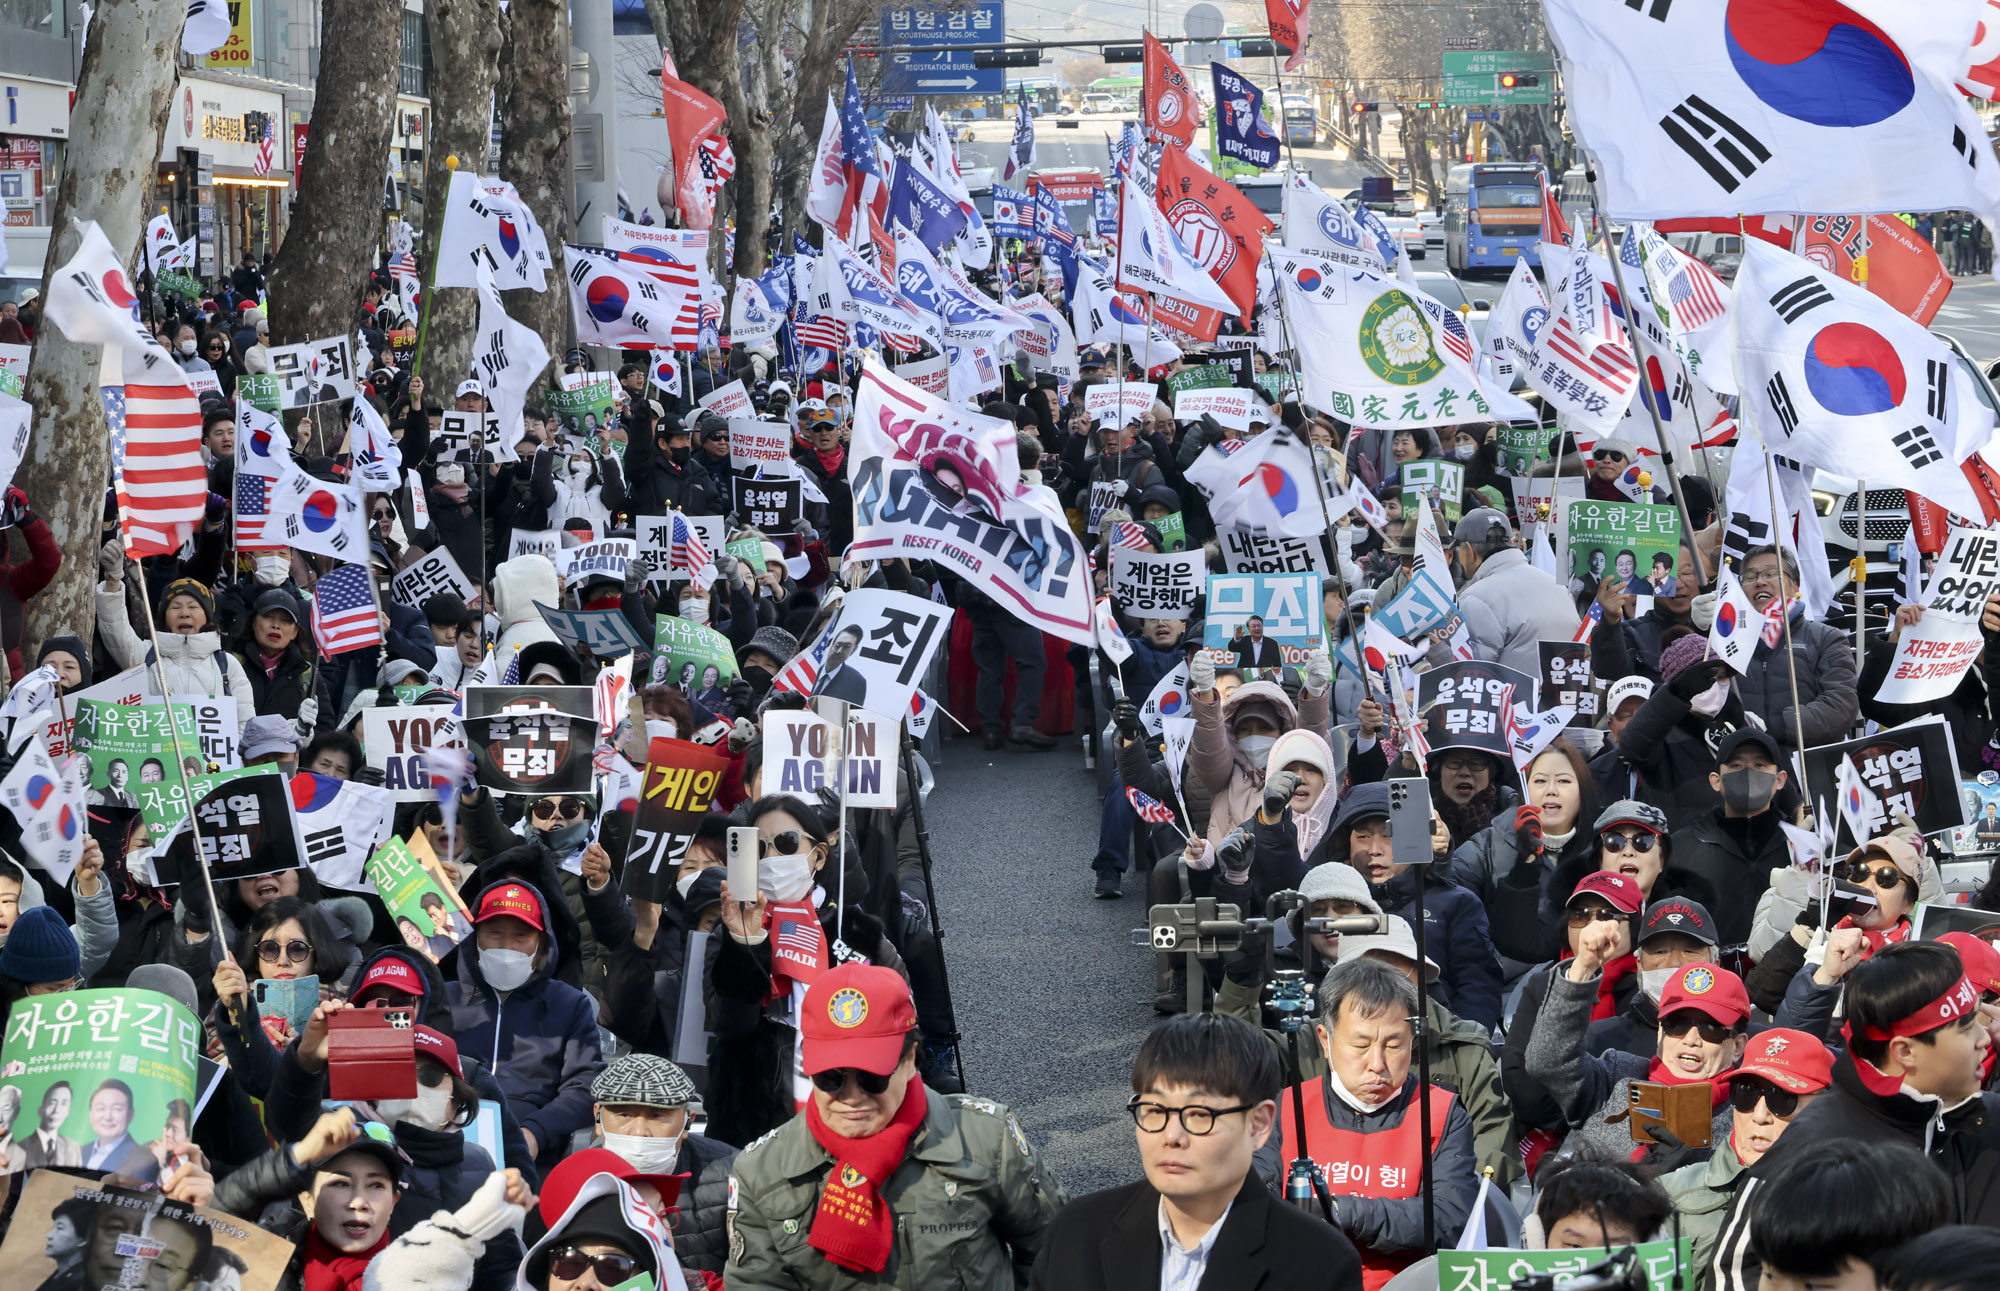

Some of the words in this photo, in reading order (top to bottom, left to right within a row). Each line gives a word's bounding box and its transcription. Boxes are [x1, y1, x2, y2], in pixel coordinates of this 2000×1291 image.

[210, 49, 250, 61] 9100
[905, 63, 951, 72] REGISTRATION
[3, 213, 31, 226] alaxy
[623, 229, 678, 243] 자유민주주의수호
[1899, 236, 1923, 255] ARMY
[156, 265, 201, 293] 자유한길단
[862, 306, 912, 331] 구국동지회
[1025, 331, 1048, 345] 판사는
[273, 341, 350, 391] 무죄
[1169, 366, 1228, 392] 자유한길단
[547, 383, 611, 406] 자유한길단
[723, 391, 744, 405] 판사는
[1215, 396, 1247, 407] 판사는
[1179, 404, 1247, 418] 공소기각하라!
[731, 432, 754, 445] 지귀연
[755, 435, 786, 449] 판사는
[1402, 462, 1464, 503] 무죄
[744, 489, 788, 509] 윤석열
[750, 511, 780, 527] 무죄
[1569, 504, 1679, 534] 자유한길단
[1917, 494, 1932, 536] ELECTION
[649, 526, 709, 548] 계은
[573, 542, 629, 561] YOON
[728, 542, 760, 559] 길단
[901, 534, 940, 550] RESET
[941, 542, 983, 574] KOREA
[566, 555, 632, 578] AGAIN
[1128, 560, 1193, 586] 계엄은
[1117, 585, 1200, 610] 정당했다
[1205, 574, 1319, 639] 무죄
[1385, 579, 1451, 634] 죄
[659, 618, 736, 659] 자유한길단
[858, 606, 940, 687] 죄
[1903, 639, 1950, 659] 지귀연
[1951, 637, 1983, 658] 판사는
[1893, 656, 1974, 680] 공소기각하라!
[1613, 681, 1648, 696] 국가원로회
[1559, 691, 1599, 716] 무죄
[78, 703, 194, 739] 자유한길단
[1445, 708, 1497, 735] 무죄
[502, 747, 556, 779] 무죄
[638, 761, 722, 812] 게인
[780, 758, 882, 795] AGAIN
[194, 834, 252, 868] 무죄
[491, 898, 532, 913] MARINES
[1647, 903, 1704, 929] SUPERMAN
[775, 947, 818, 969] AGAIN
[385, 965, 408, 977] AGAIN
[9, 995, 199, 1070] 자유한길단
[1378, 1164, 1406, 1189] 형!
[162, 1206, 183, 1220] 위한
[183, 1212, 204, 1226] 거대
[919, 1220, 979, 1234] PROPPER
